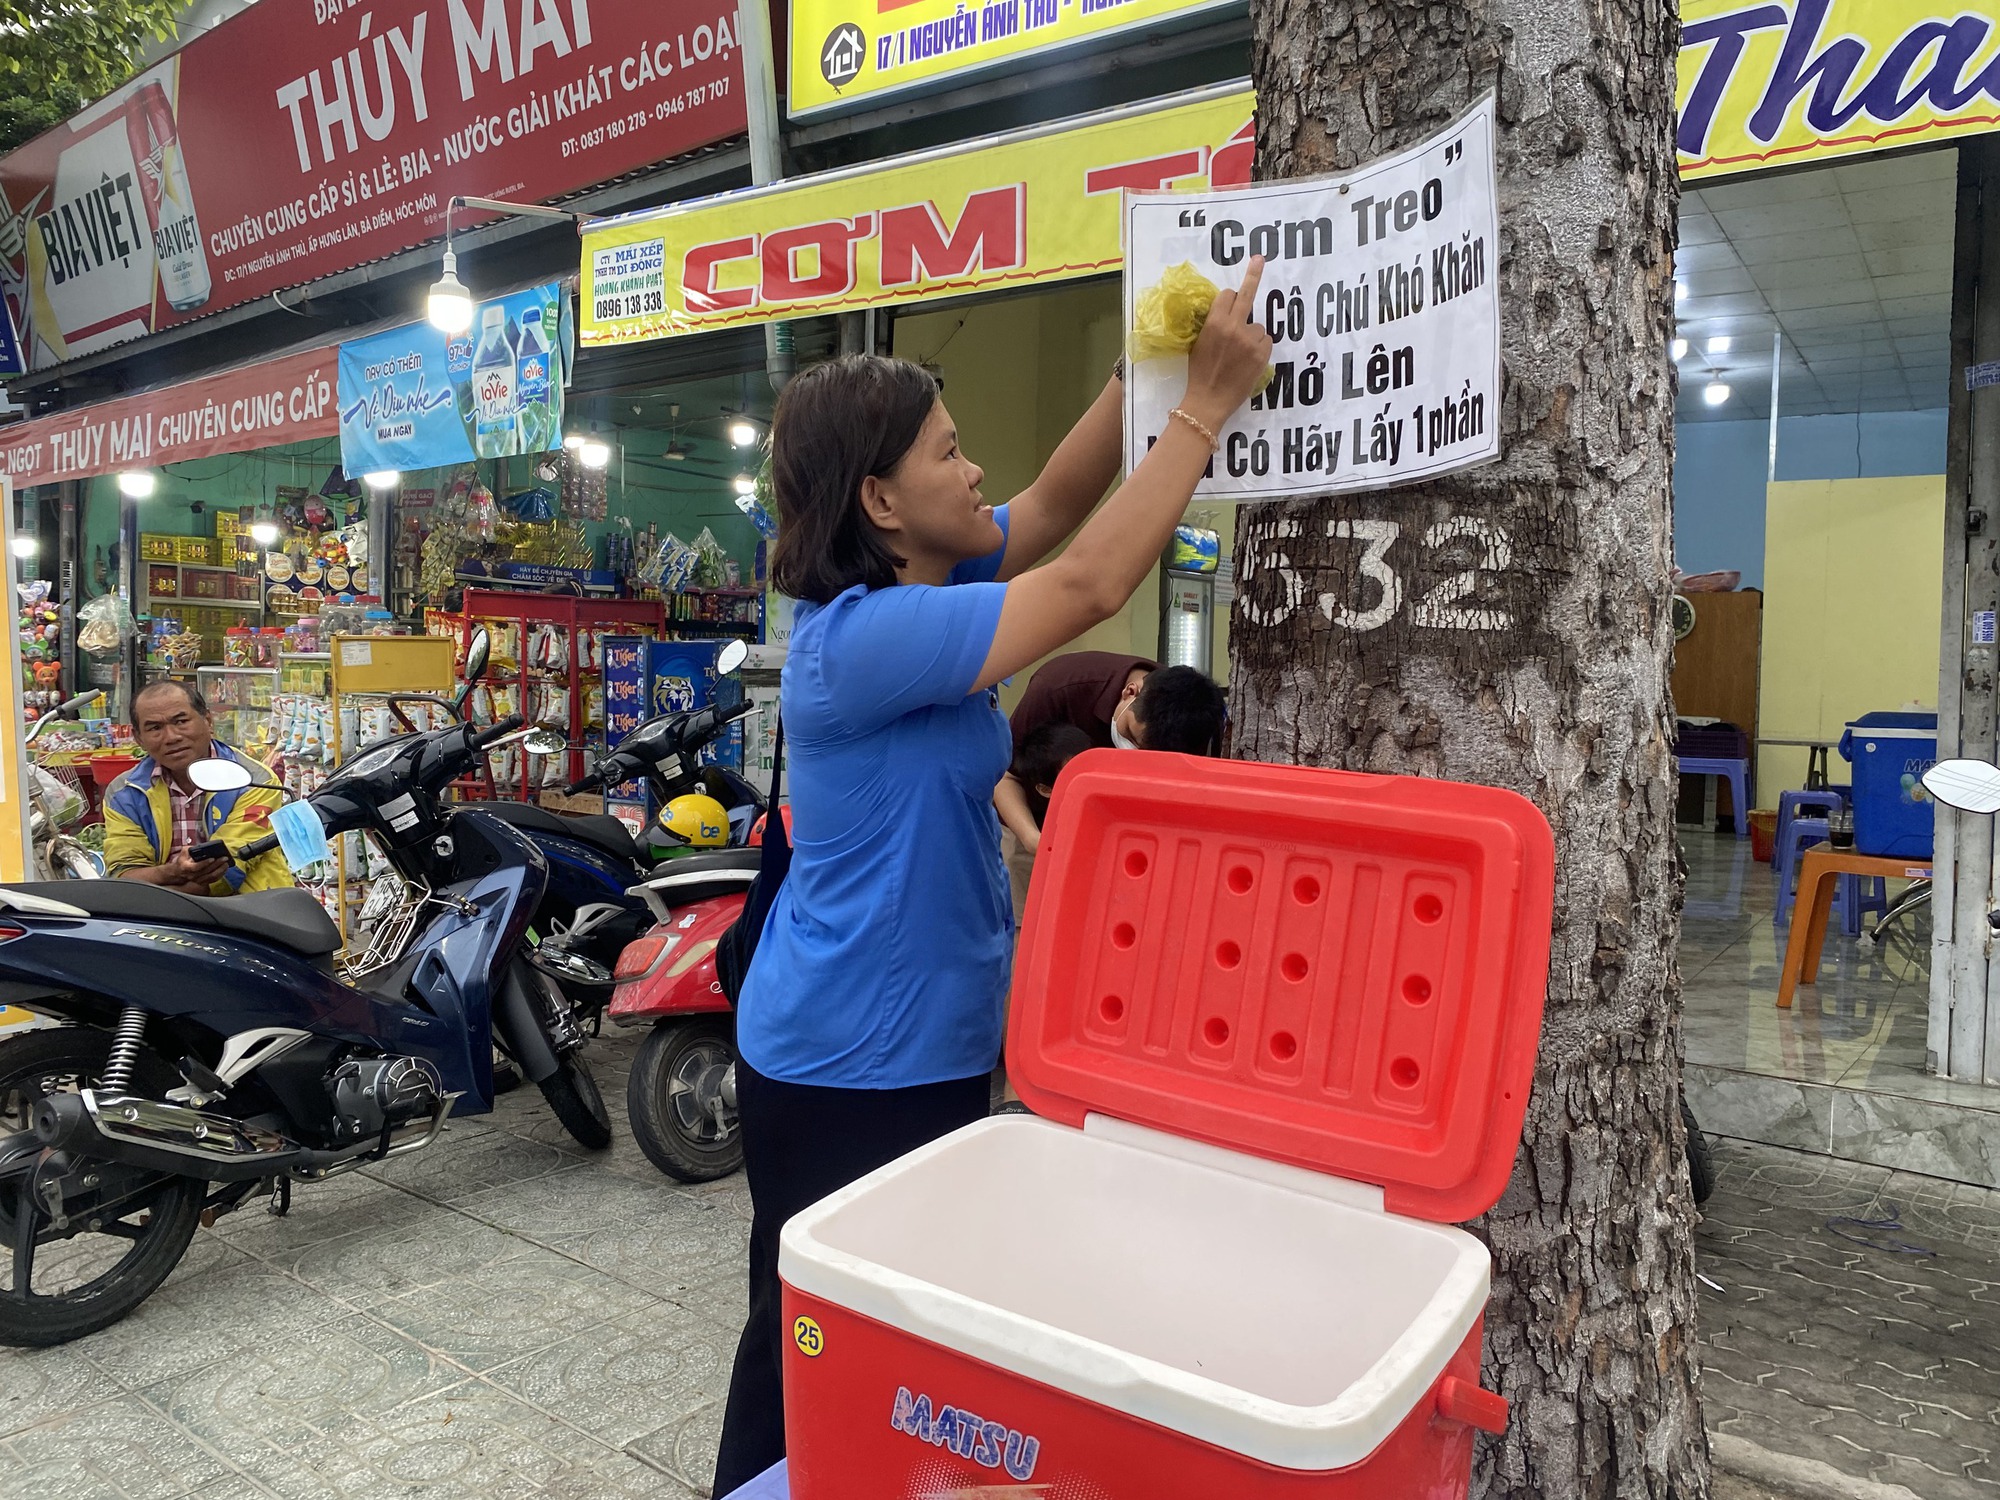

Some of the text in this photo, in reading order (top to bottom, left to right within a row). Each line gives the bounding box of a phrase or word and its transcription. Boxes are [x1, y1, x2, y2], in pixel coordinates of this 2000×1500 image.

[909, 5, 977, 62] NGUYỄN
[276, 0, 593, 174] THÚY MAI
[1677, 0, 2000, 155] Tha
[211, 212, 264, 257] CHUYÊN
[264, 198, 306, 236] CUNG
[308, 177, 339, 219] CẤP
[342, 171, 357, 207] SỈ
[360, 173, 373, 200] &
[400, 148, 432, 184] BIA
[443, 115, 504, 166] NƯỚC
[506, 90, 551, 143] GIẢI
[553, 65, 613, 121] KHÁT
[619, 40, 673, 92] CÁC
[677, 10, 742, 69] LOẠI
[561, 138, 579, 157] ĐT:
[580, 127, 604, 150] 0837
[606, 119, 625, 139] 180
[627, 110, 647, 132] 278
[655, 95, 685, 121] 0946
[686, 86, 706, 109] 787
[709, 76, 730, 100] 707
[319, 230, 342, 250] HƯNG
[395, 201, 415, 221] HÓC
[415, 193, 437, 214] MÔN
[683, 183, 1027, 314] CƠM
[615, 241, 663, 262] MÁI XẾP
[617, 258, 662, 275] DI ĐỘNG
[596, 291, 662, 319] 0896 138 338
[1265, 229, 1485, 344] Cô Chú Khó Khăn
[383, 354, 395, 377] CÓ
[396, 350, 422, 373] THÊM
[1251, 343, 1414, 411] Mở Lên
[7, 443, 42, 477] NGỌT
[50, 416, 105, 474] THÚY
[110, 413, 151, 463] MAI
[158, 398, 227, 447] CHUYÊN
[230, 387, 283, 433] CUNG
[289, 369, 330, 422] CẤP
[377, 422, 412, 440] MUA NGAY
[1227, 429, 1270, 478] Có
[1282, 423, 1340, 474] Hãy
[1353, 402, 1403, 464] Lấy
[1240, 505, 1514, 632] 532
[614, 648, 637, 667] Tiger
[614, 680, 637, 700] Tiger
[614, 713, 637, 732] Tiger
[700, 821, 720, 838] be
[797, 1321, 820, 1351] 25
[891, 1386, 1041, 1482] MATSU
